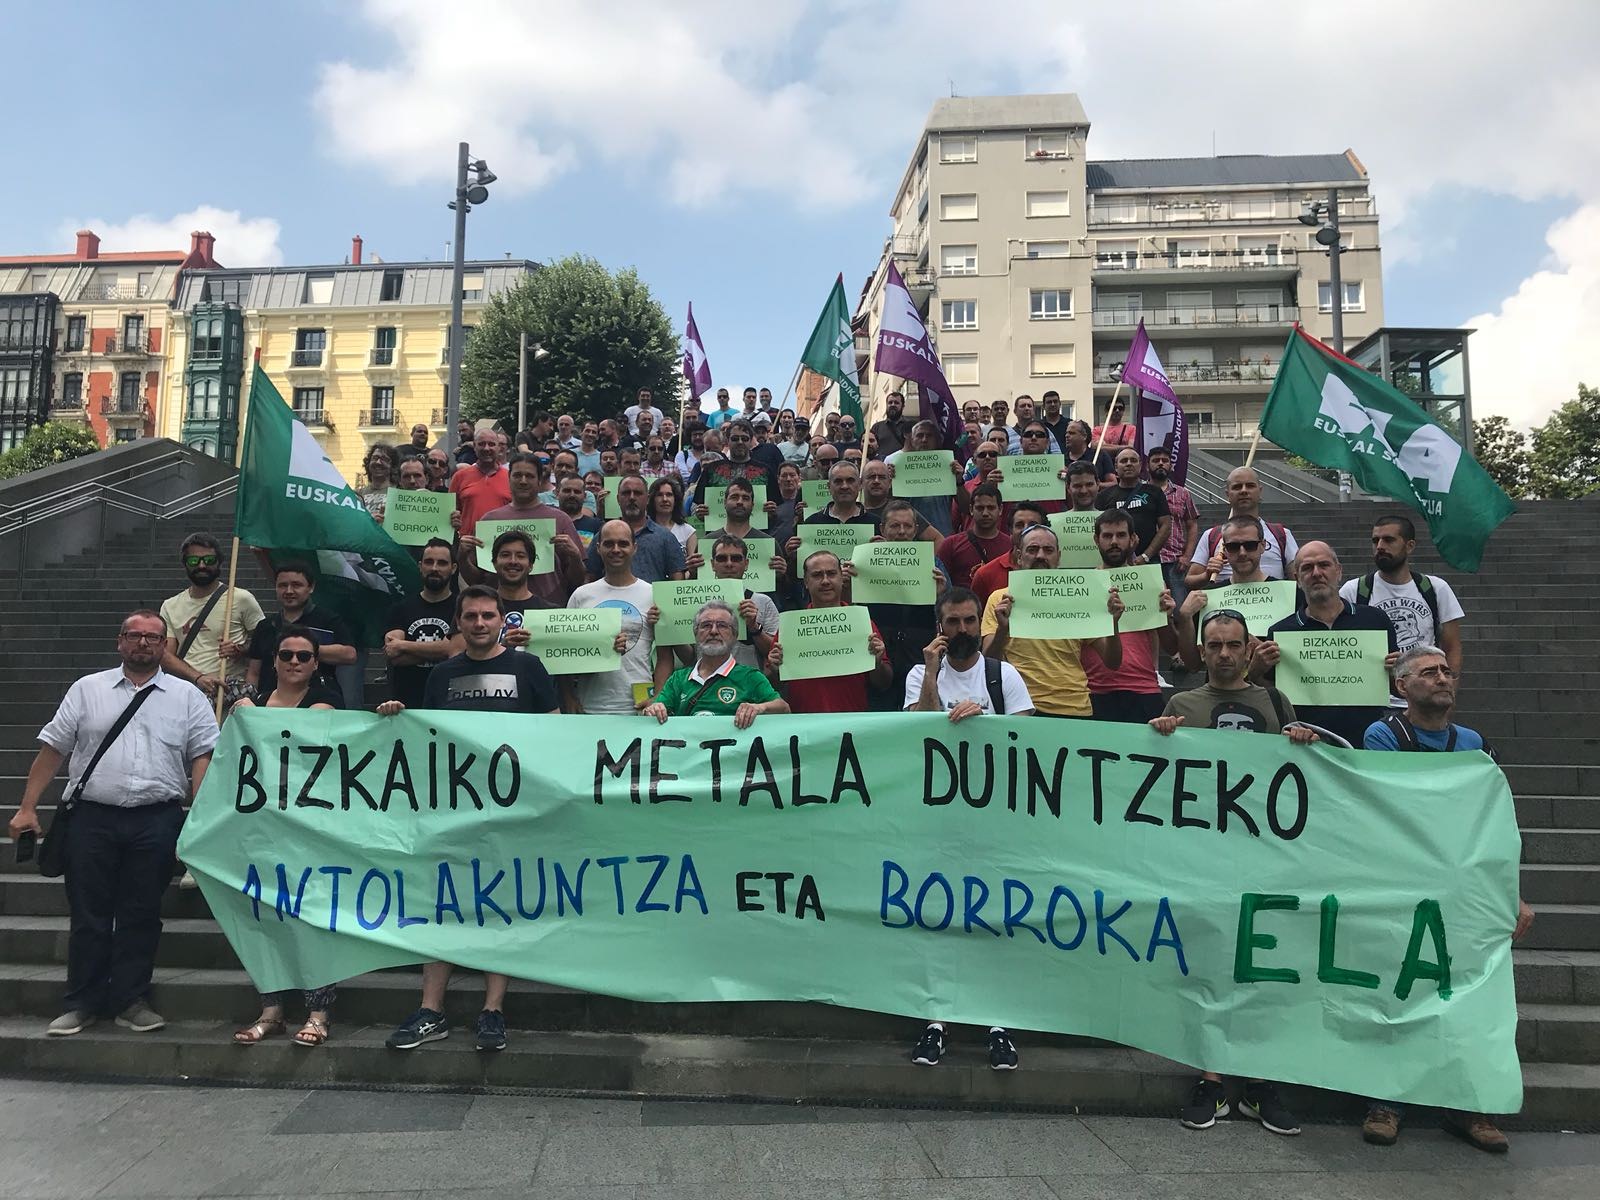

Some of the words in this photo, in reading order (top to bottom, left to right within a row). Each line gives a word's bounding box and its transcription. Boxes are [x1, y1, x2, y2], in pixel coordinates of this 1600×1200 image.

[904, 462, 941, 470] METALEAN
[285, 483, 366, 512] EUSKAL
[398, 494, 438, 505] BIZKAIKO
[394, 504, 440, 514] METALEAN
[393, 523, 439, 533] BORROKA
[816, 529, 855, 537] BIZKAIKO
[814, 538, 858, 546] METALEAN
[873, 547, 917, 556] BIZKAIKO
[869, 558, 920, 566] METALEAN
[1034, 575, 1085, 585] BIZKAIKO
[1109, 571, 1139, 583] KAIKO
[676, 585, 721, 595] BIZKAIKO
[1031, 587, 1089, 597] METALEAN
[1223, 587, 1270, 597] BIZKAIKO
[1219, 596, 1274, 608] METALEAN
[1377, 600, 1397, 610] TAR
[549, 613, 597, 623] BIZKAIKO
[800, 612, 847, 625] BIZKAIKO
[545, 624, 600, 633] METALEAN
[797, 624, 852, 637] METALEAN
[1303, 637, 1358, 647] BIZKAIKO
[545, 647, 601, 658] BORROKA
[798, 647, 855, 658] ANTOLAKUNTZA
[1299, 650, 1363, 660] METALEAN
[1300, 676, 1364, 684] MOBILIZAZIOA
[593, 732, 871, 809] METALA
[736, 872, 826, 922] ETA
[881, 860, 1189, 976] BORROKA
[1233, 893, 1452, 1001] ELA
